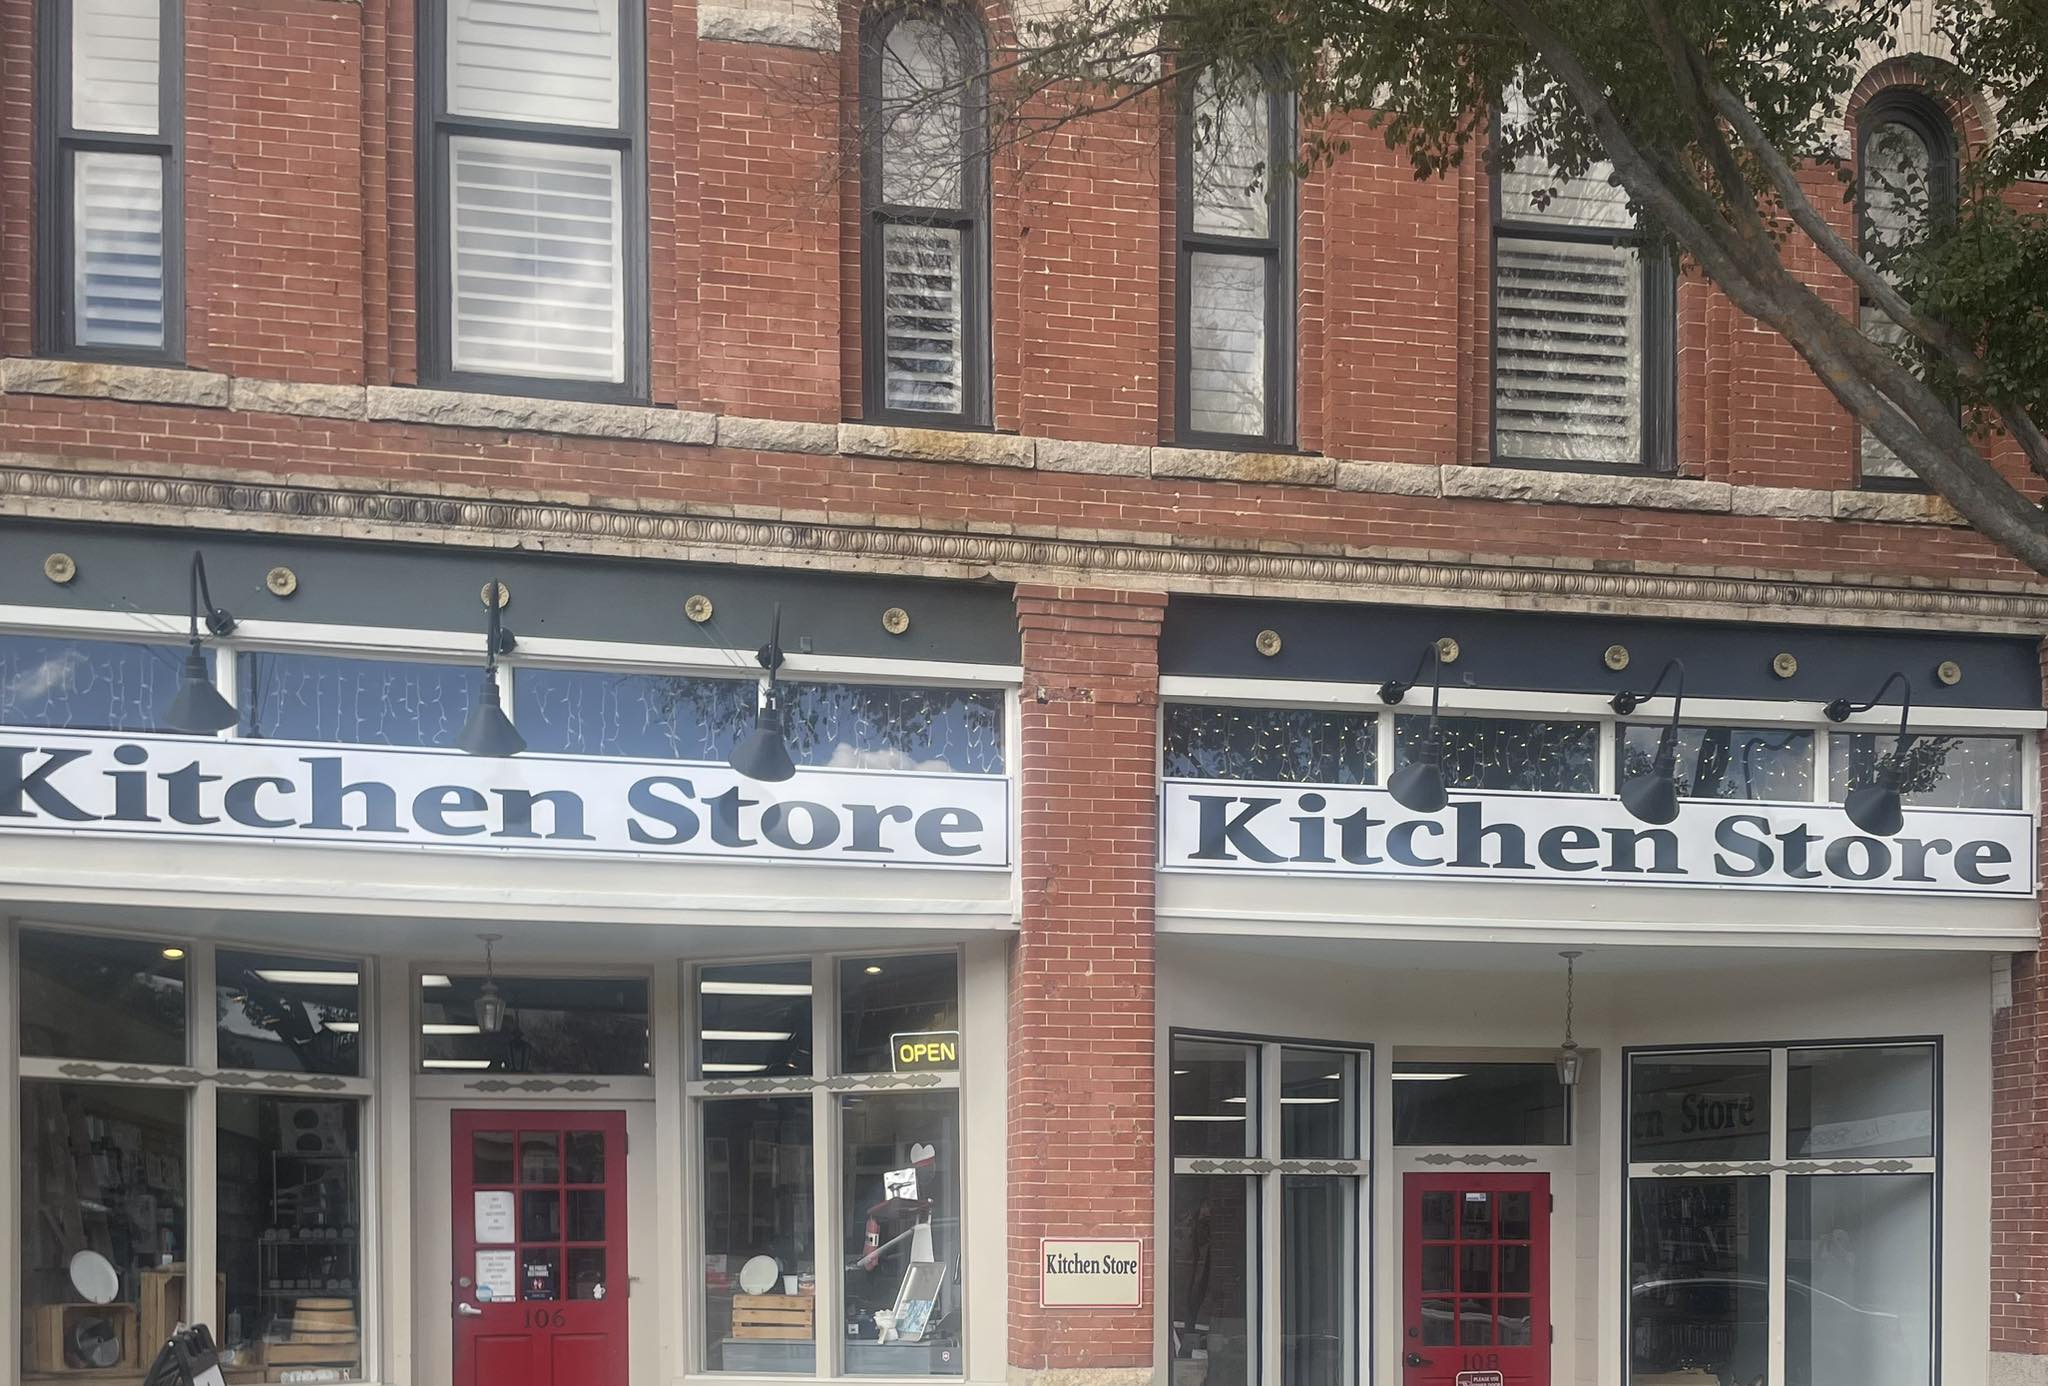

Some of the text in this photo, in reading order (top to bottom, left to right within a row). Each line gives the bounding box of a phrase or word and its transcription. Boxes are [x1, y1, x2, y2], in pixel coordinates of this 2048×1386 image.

[0, 744, 984, 857] Kitchen Store
[1187, 792, 2012, 885] Kitchen Store
[900, 1042, 956, 1063] OPEN
[1046, 1252, 1137, 1275] Kitchen Store
[523, 1308, 566, 1328] 106
